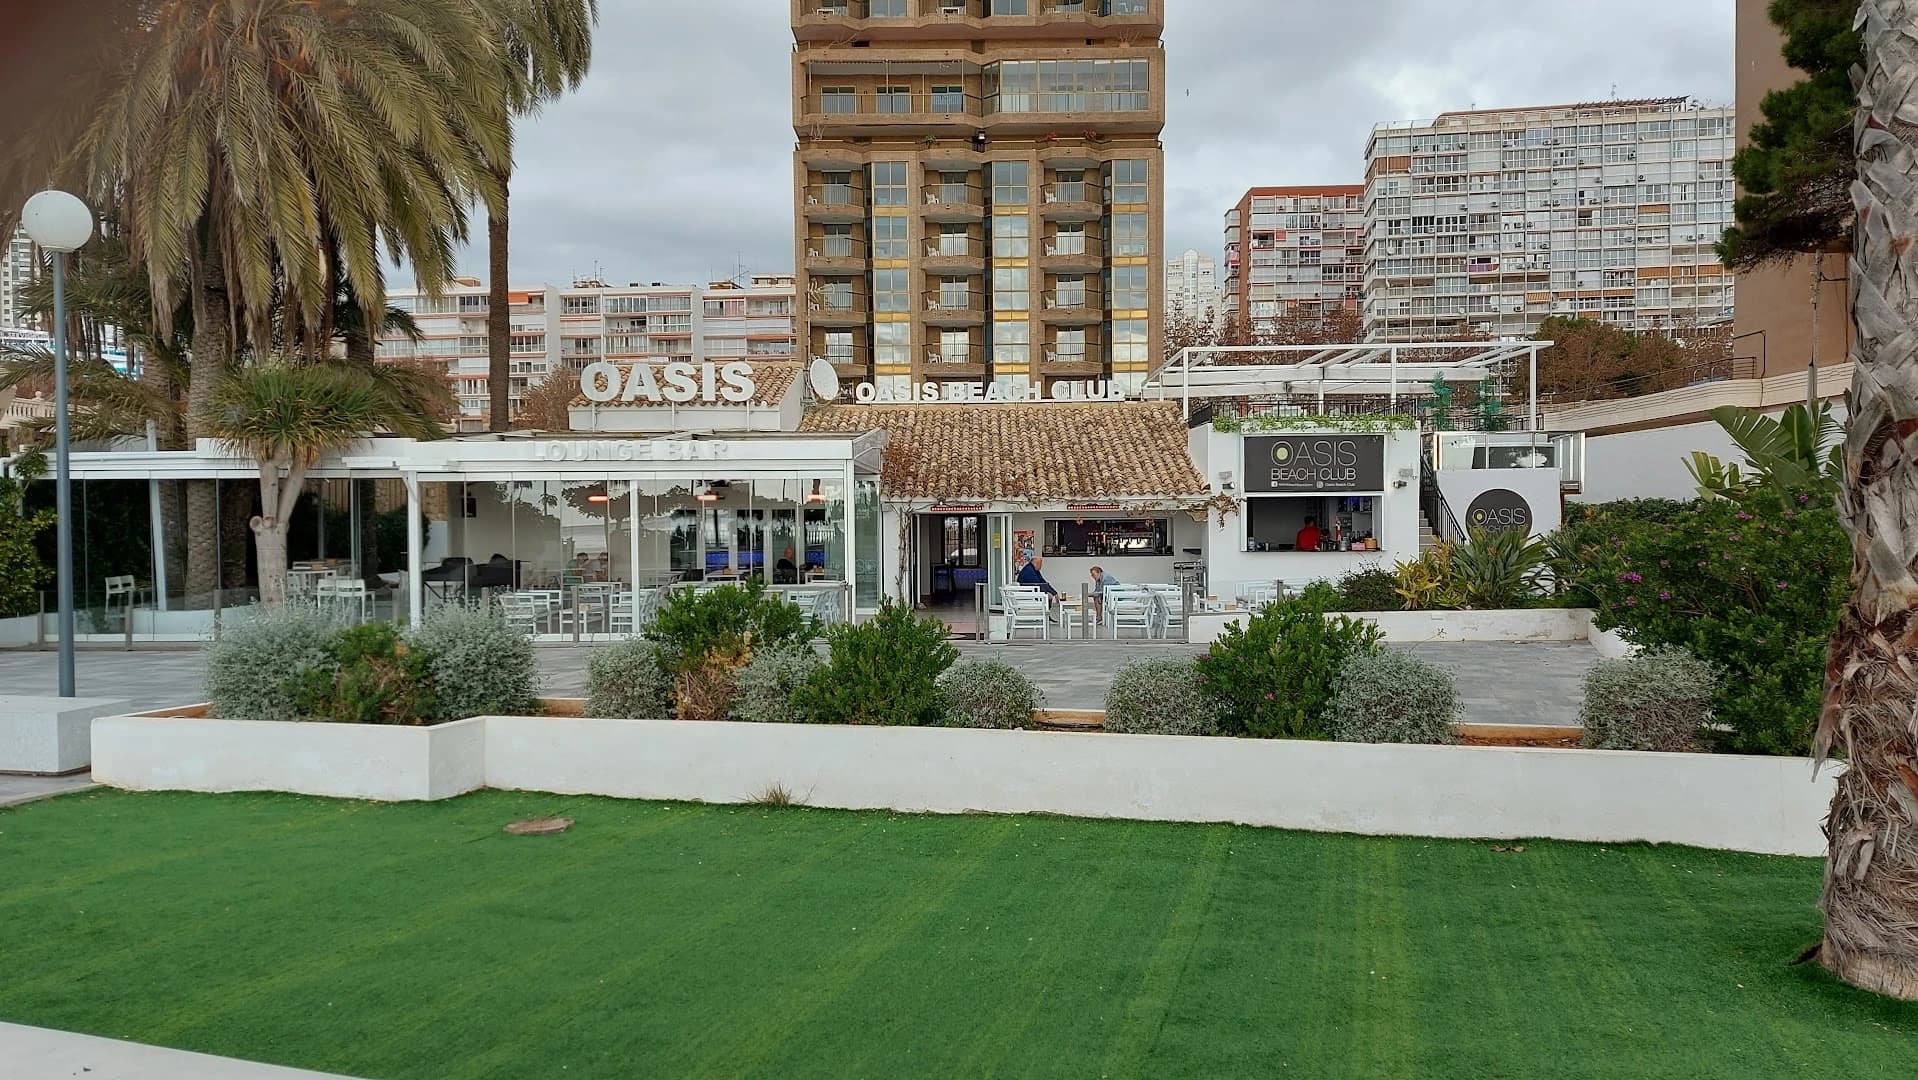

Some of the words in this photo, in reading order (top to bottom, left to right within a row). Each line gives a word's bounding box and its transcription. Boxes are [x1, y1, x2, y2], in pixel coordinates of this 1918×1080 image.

[580, 361, 755, 402] OASIS
[855, 382, 938, 401] OASIS
[950, 381, 1042, 400] BEACH
[1051, 380, 1126, 400] CLUB
[532, 440, 653, 462] LOUNGE
[669, 440, 728, 461] BAR
[1271, 441, 1357, 466] OASIS
[1271, 468, 1316, 480] BEACH
[1320, 468, 1357, 480] CLUB
[1472, 507, 1526, 525] OASIS
